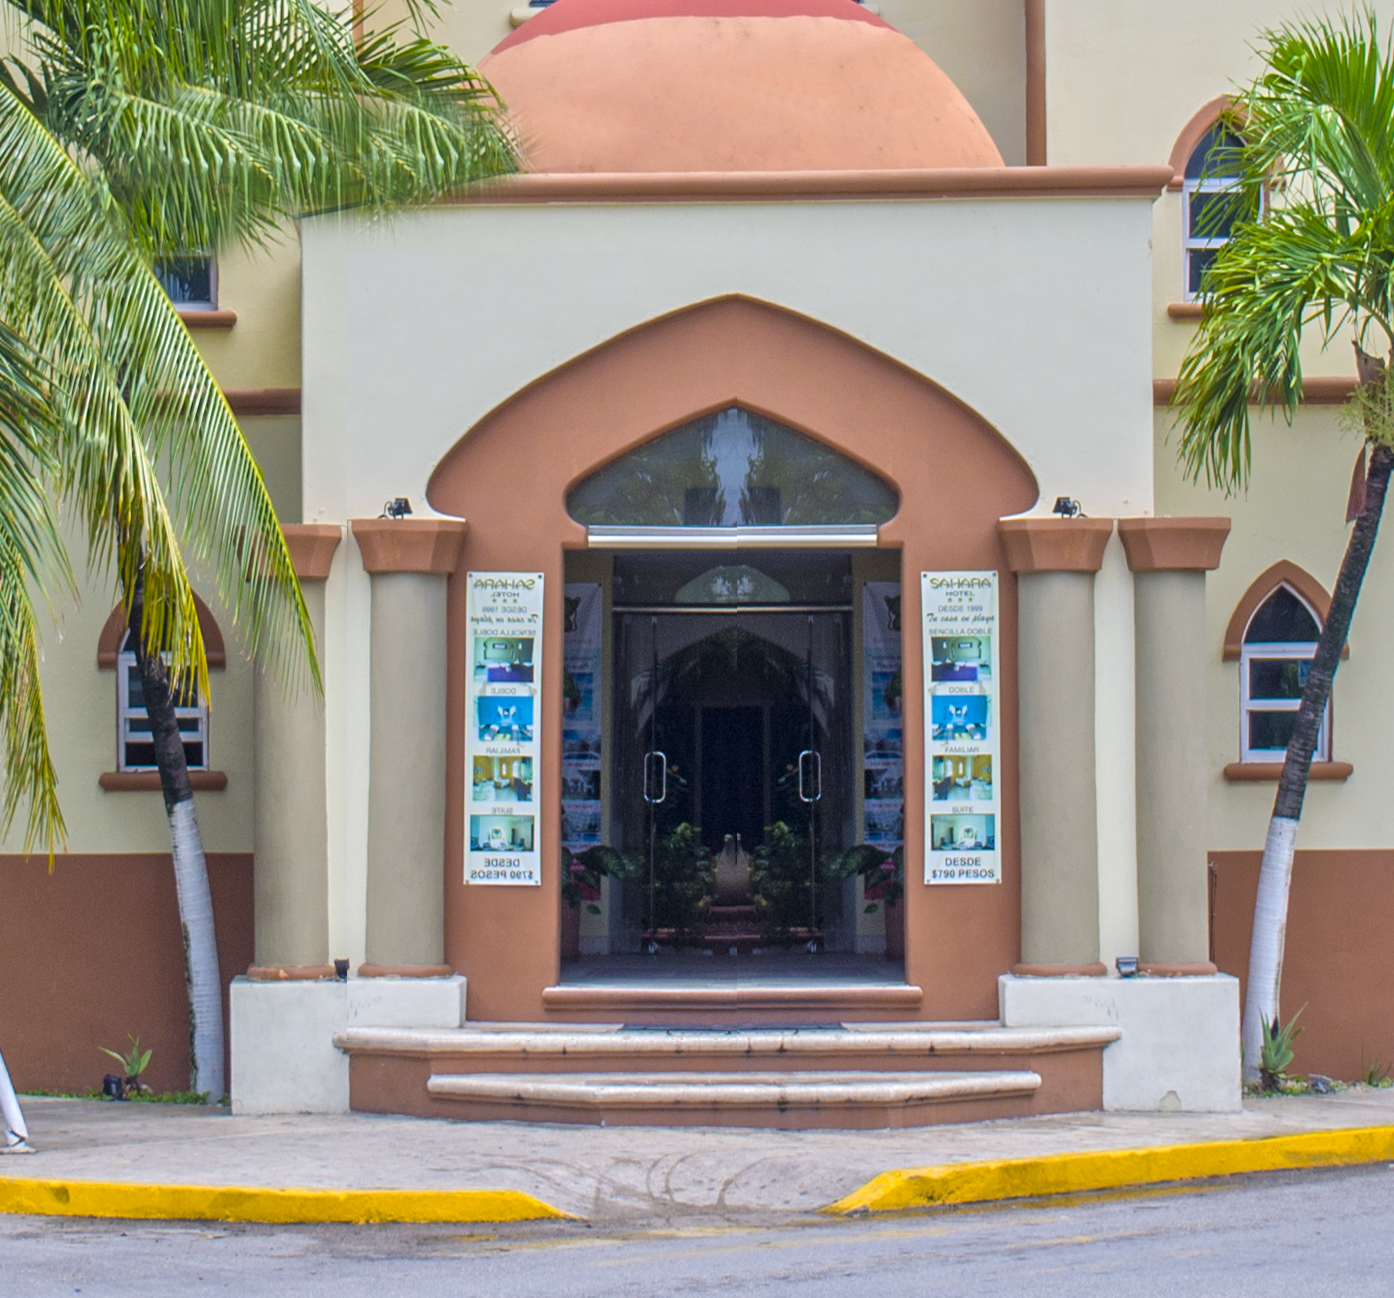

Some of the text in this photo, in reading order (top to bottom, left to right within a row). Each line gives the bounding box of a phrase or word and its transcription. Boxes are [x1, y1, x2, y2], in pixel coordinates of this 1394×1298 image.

[929, 576, 992, 590] SAHARA
[937, 604, 964, 612] DESDE
[926, 612, 938, 622] Tu
[971, 613, 995, 624] playa
[928, 627, 993, 635] SENCILLA DOBLE
[948, 686, 975, 694] DOBLE
[944, 746, 980, 754] FAMILIAR
[944, 856, 982, 866] DESDE
[931, 868, 995, 879] $790 PESOS
